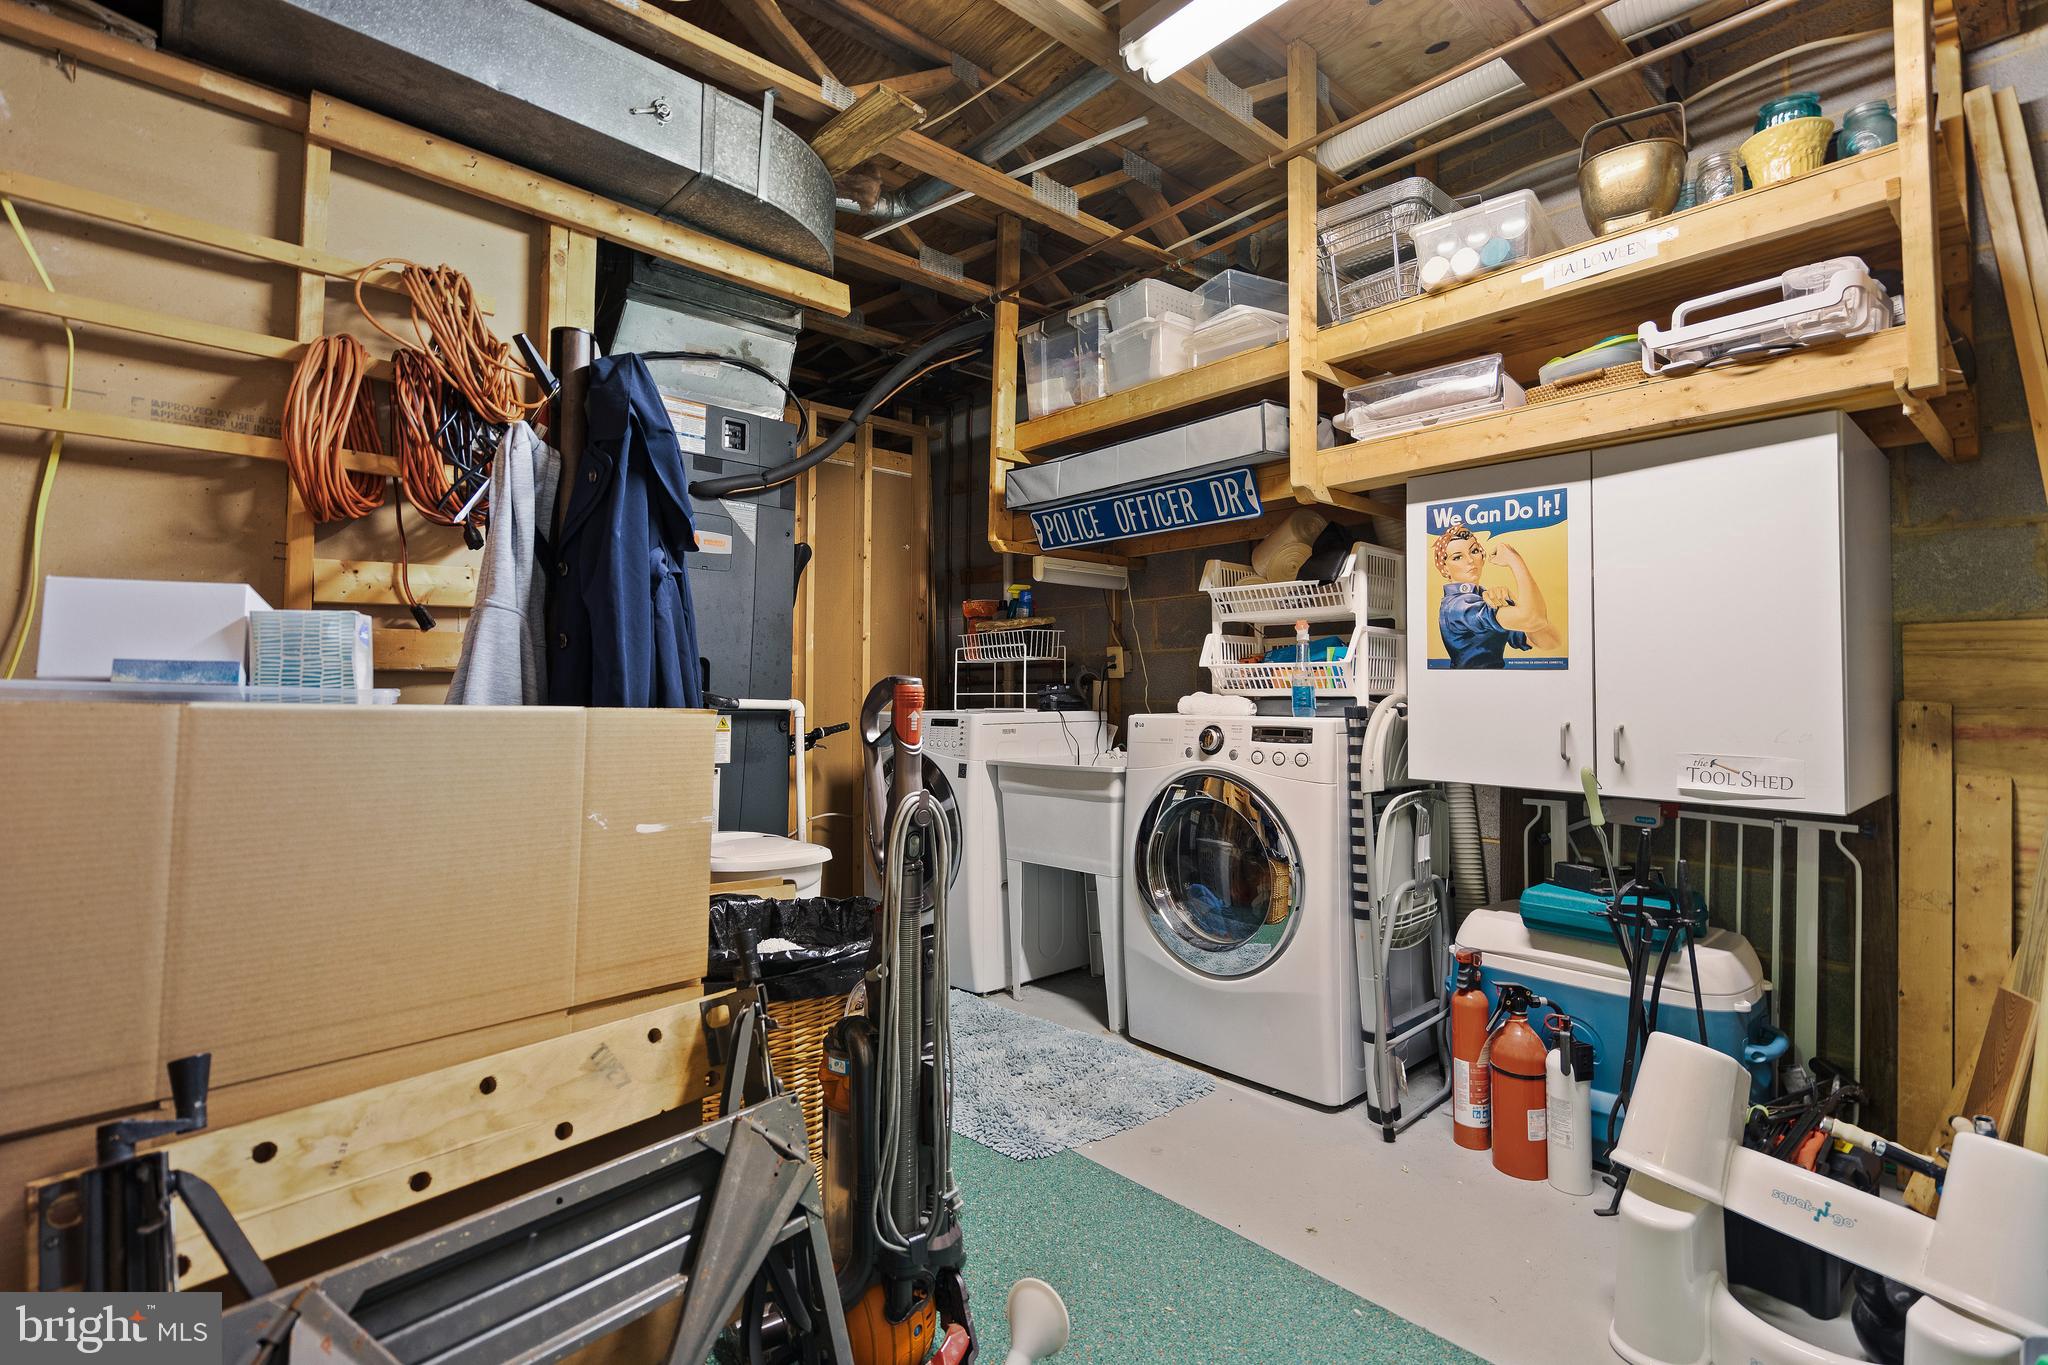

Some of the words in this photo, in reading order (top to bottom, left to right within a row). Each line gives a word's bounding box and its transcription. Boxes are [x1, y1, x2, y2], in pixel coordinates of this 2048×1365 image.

[151, 399, 213, 415] APPROVED
[217, 408, 232, 418] BY
[258, 415, 281, 426] BOA
[204, 416, 227, 428] FOR
[1042, 505, 1105, 545] POLICE
[1113, 487, 1198, 534] OFFICER
[1210, 477, 1245, 517] DR
[1433, 506, 1462, 529] We
[1464, 503, 1501, 525] Can
[1505, 499, 1534, 521] Do
[1537, 493, 1561, 518] It!
[1693, 757, 1709, 768] the
[1686, 766, 1737, 787] TOOL
[1740, 770, 1794, 791] SHED
